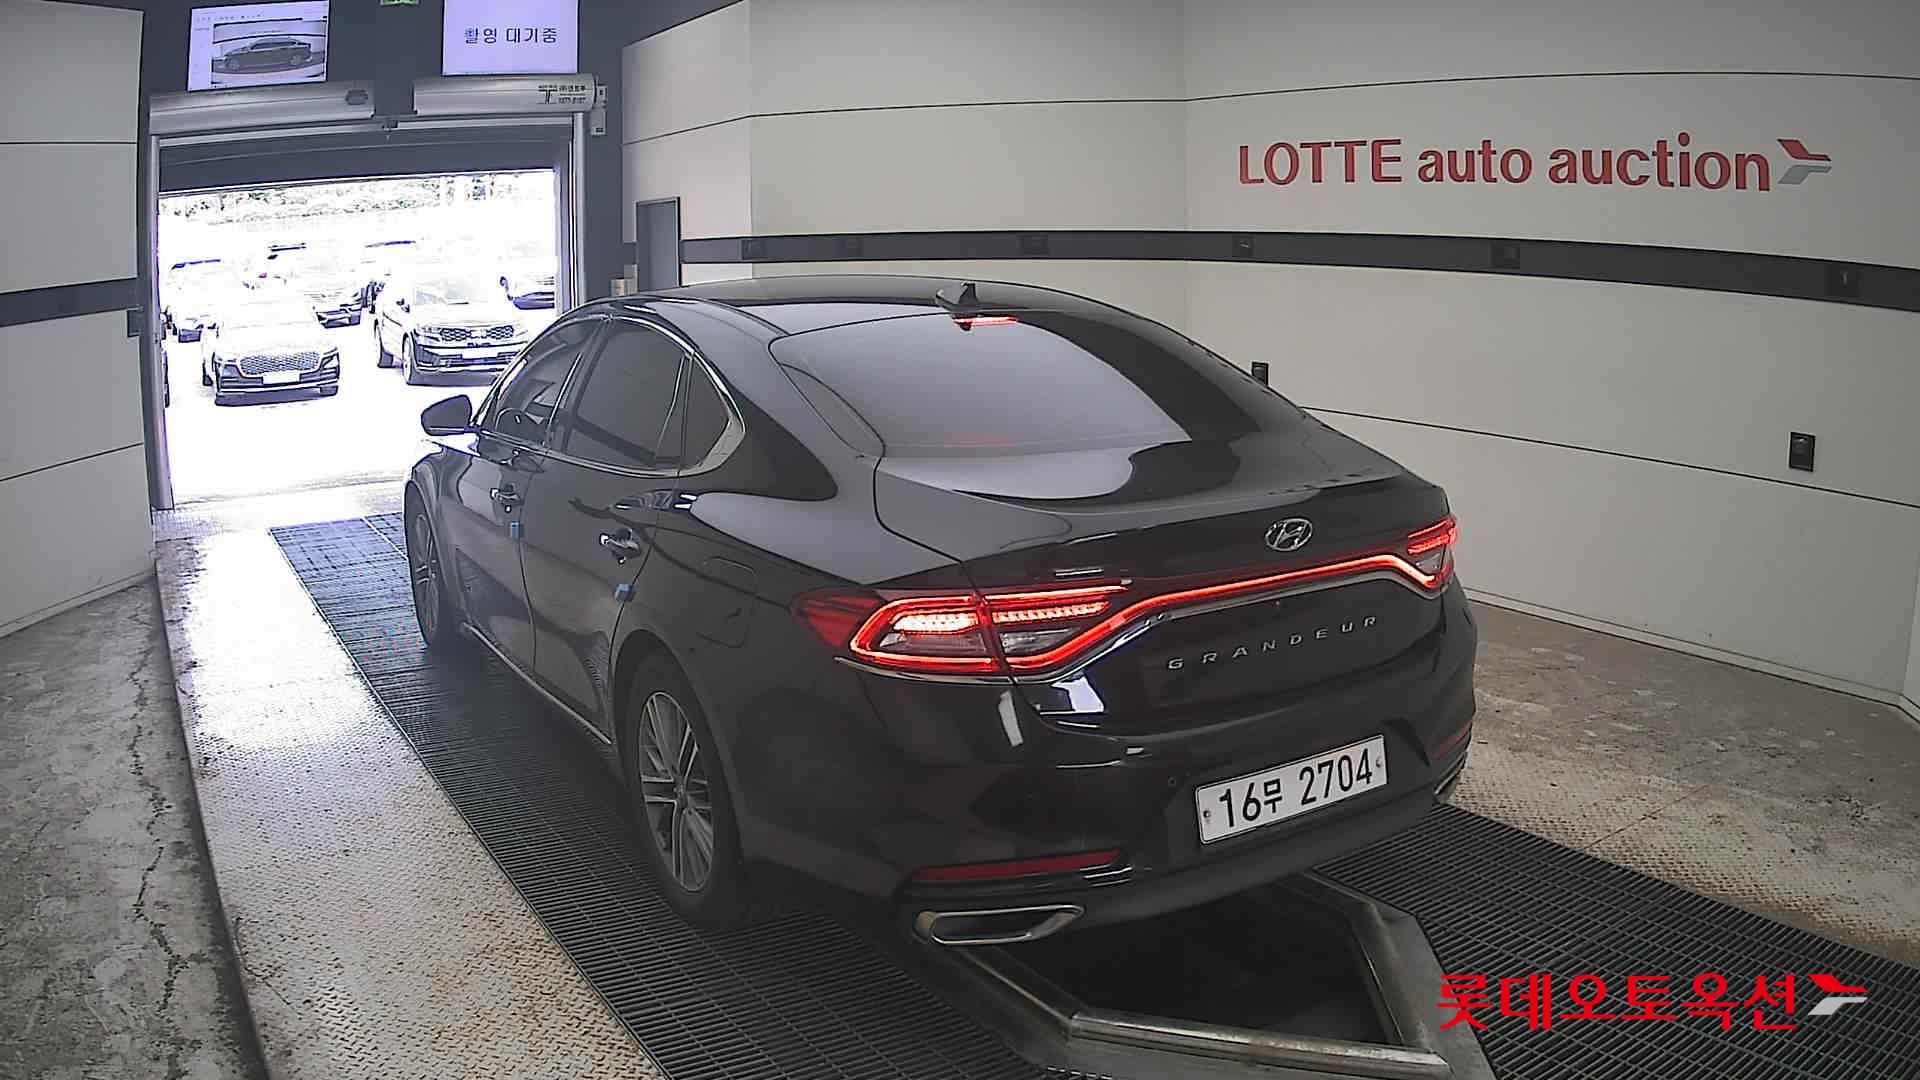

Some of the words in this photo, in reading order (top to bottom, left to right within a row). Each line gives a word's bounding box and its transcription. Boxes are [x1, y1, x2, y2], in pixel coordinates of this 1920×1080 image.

[507, 27, 557, 44] 대기중
[1239, 139, 1401, 185] LOTTE
[1417, 140, 1533, 183] auto
[1548, 132, 1771, 191] auction
[1167, 616, 1377, 670] GRANDEUR
[1219, 778, 1283, 828] 16무
[1299, 748, 1373, 806] 2704
